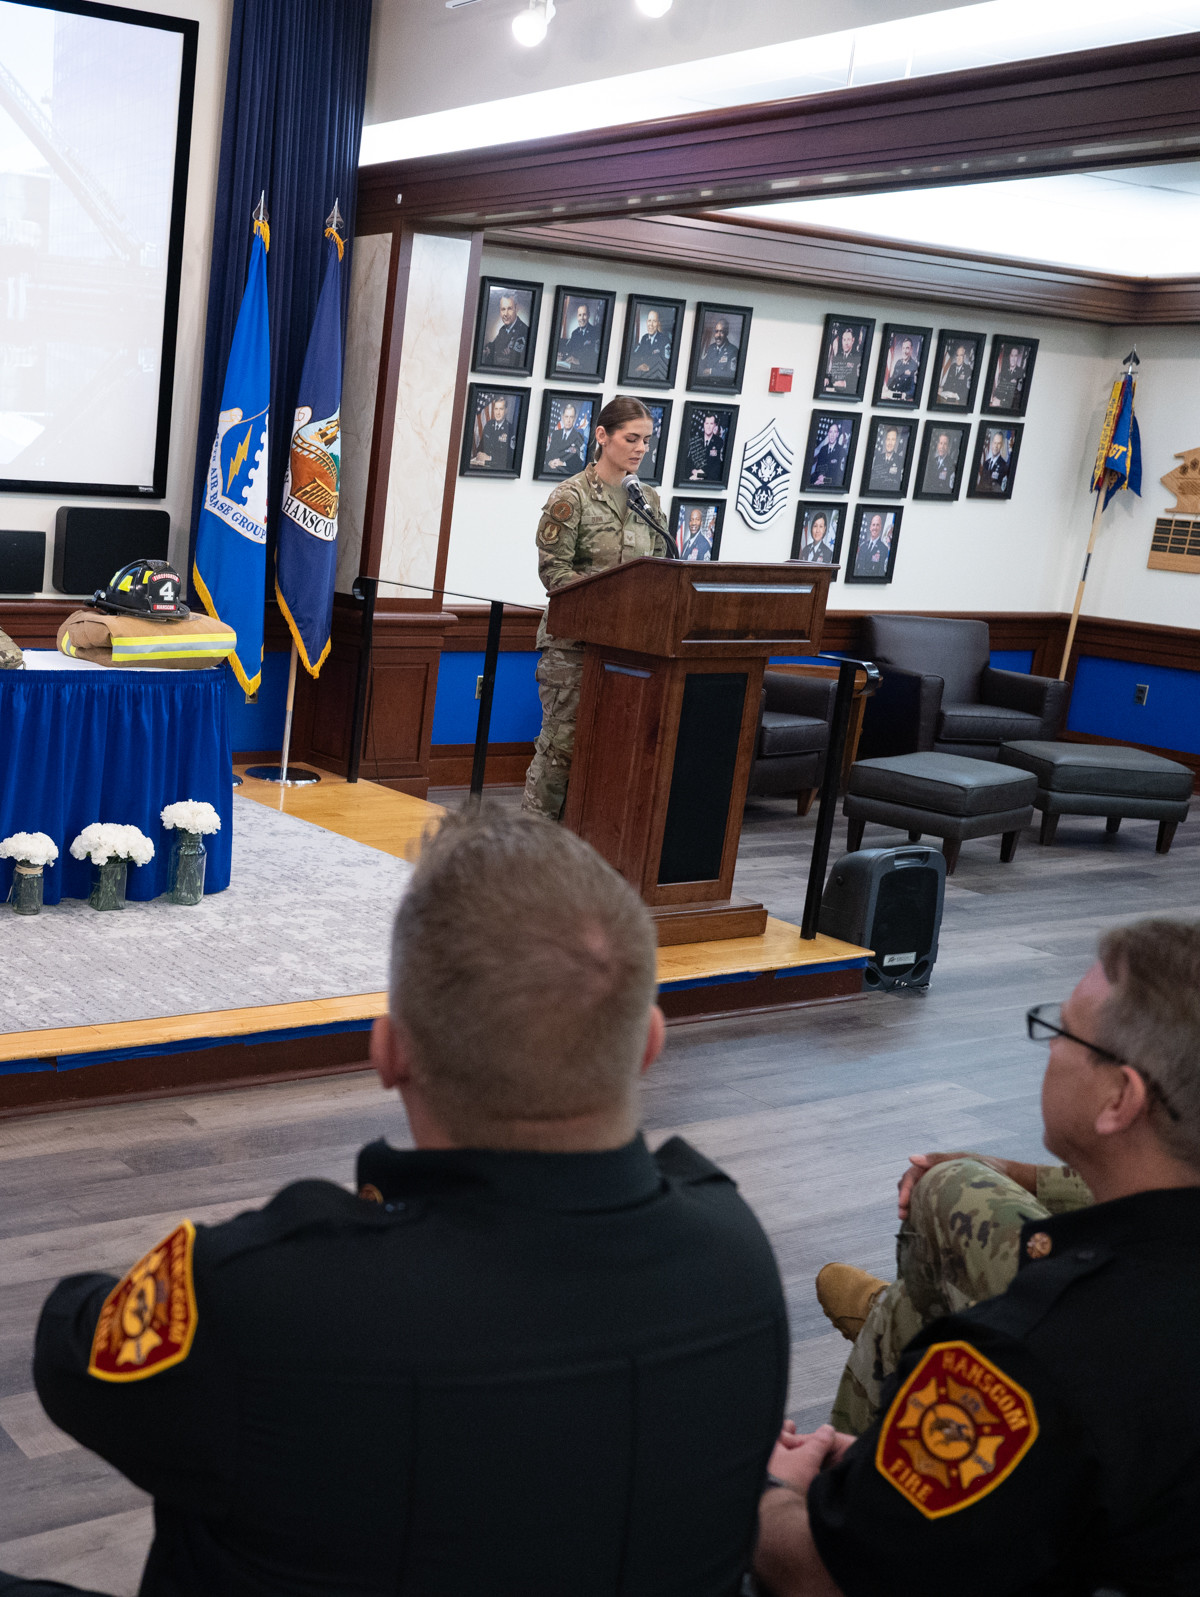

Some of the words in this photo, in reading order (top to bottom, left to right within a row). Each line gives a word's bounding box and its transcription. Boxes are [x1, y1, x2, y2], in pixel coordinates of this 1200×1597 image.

[209, 467, 219, 493] AIR
[209, 492, 233, 515] BASE
[231, 511, 267, 540] GROUP
[159, 581, 175, 601] 4
[941, 1350, 1029, 1433] HANSCOM
[887, 1458, 934, 1504] FIRE
